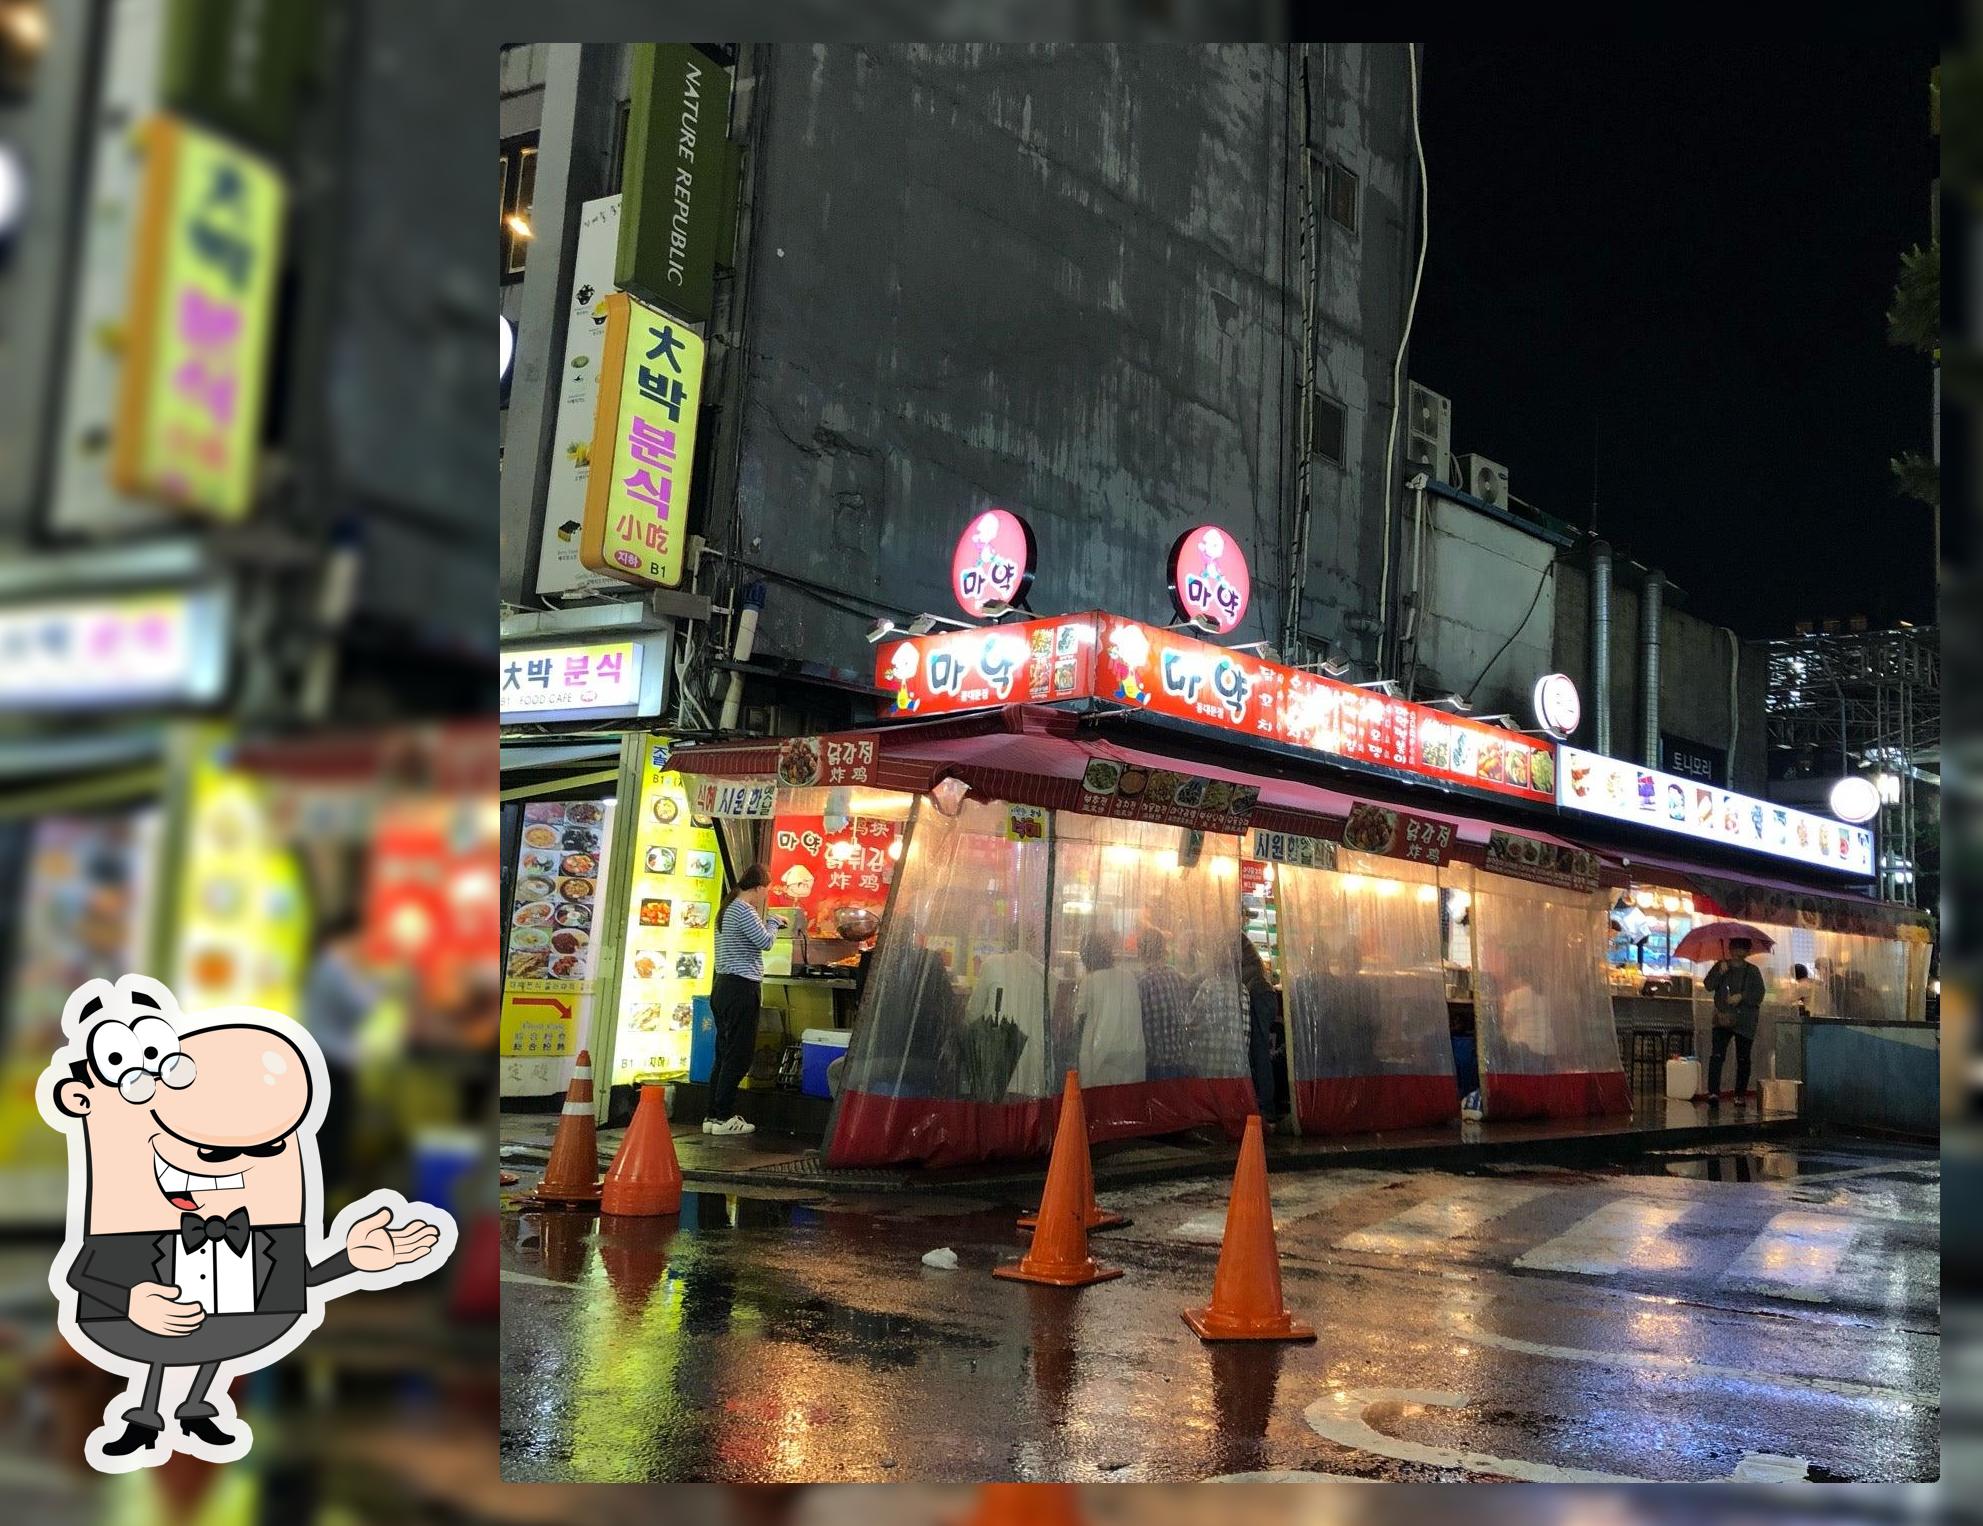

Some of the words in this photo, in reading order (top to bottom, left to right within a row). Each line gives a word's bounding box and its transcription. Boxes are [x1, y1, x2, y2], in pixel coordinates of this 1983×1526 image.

[678, 62, 702, 164] NATURE
[667, 166, 693, 287] REPUBLIC
[623, 415, 677, 521] 분식
[616, 514, 668, 555] 小吃
[617, 551, 640, 568] 지하
[650, 561, 667, 578] B1
[963, 561, 1015, 596] 마약
[1188, 580, 1240, 617] 마약
[563, 652, 624, 687] 분식
[931, 636, 1014, 691] 마약
[827, 740, 874, 766] 닭강정
[1672, 751, 1712, 781] 토니모리
[829, 765, 868, 784] 炸鸡
[719, 787, 763, 815] 시원한
[779, 833, 822, 856] 마약
[1255, 832, 1299, 863] 시원한
[1406, 818, 1451, 849] 닭강정
[828, 871, 880, 893] 炸鸡
